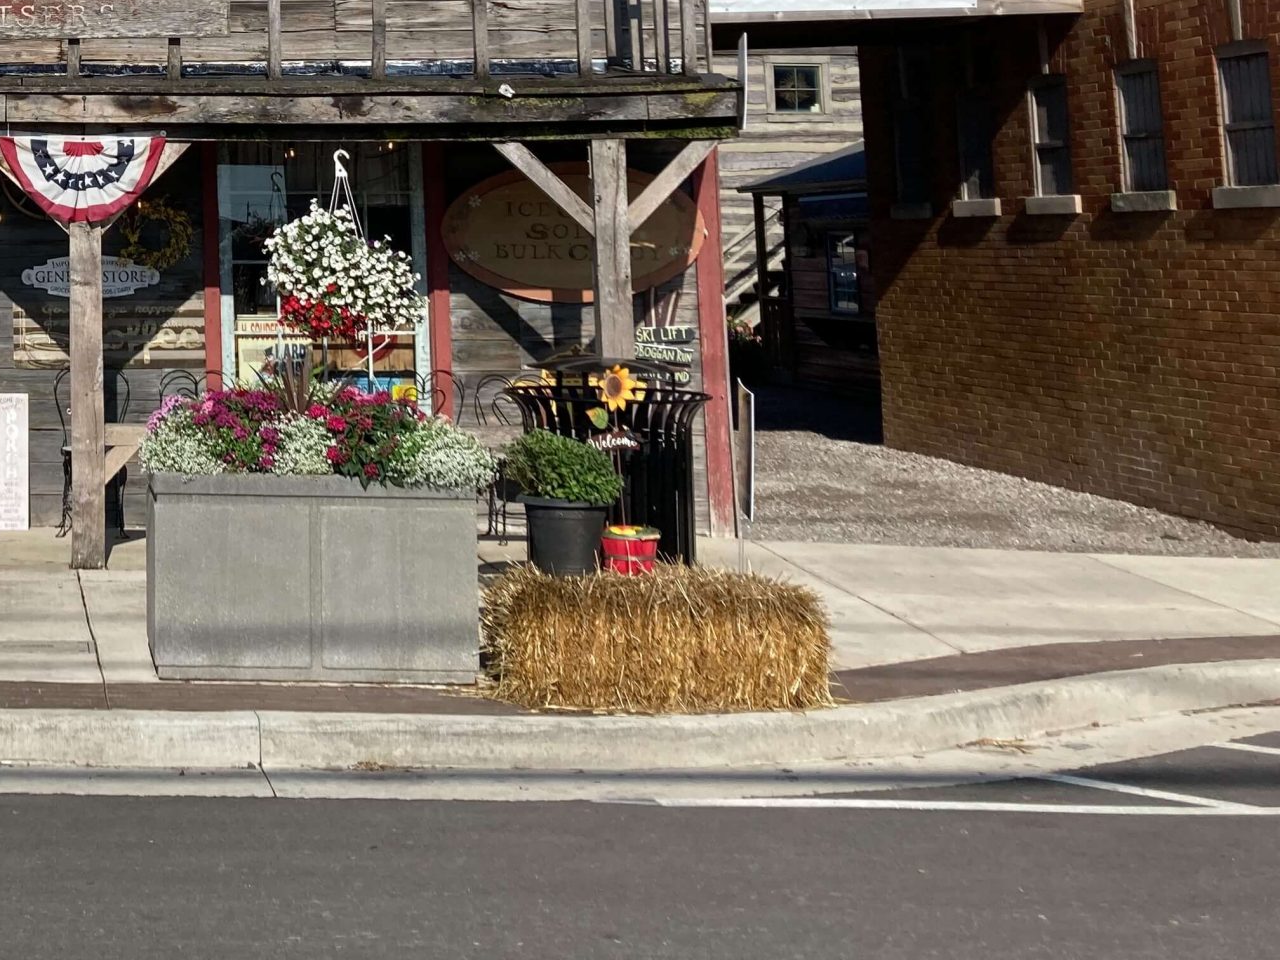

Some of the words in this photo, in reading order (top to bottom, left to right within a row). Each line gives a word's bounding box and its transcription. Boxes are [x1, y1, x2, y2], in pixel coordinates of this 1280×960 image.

[503, 200, 549, 218] ICE
[495, 242, 563, 261] BULK
[567, 242, 662, 262] CDY
[35, 270, 70, 283] GENE
[103, 270, 146, 283] STORE
[636, 328, 655, 342] SKI
[660, 326, 686, 341] LIFT
[676, 349, 693, 363] RUN
[586, 432, 639, 452] Welcome
